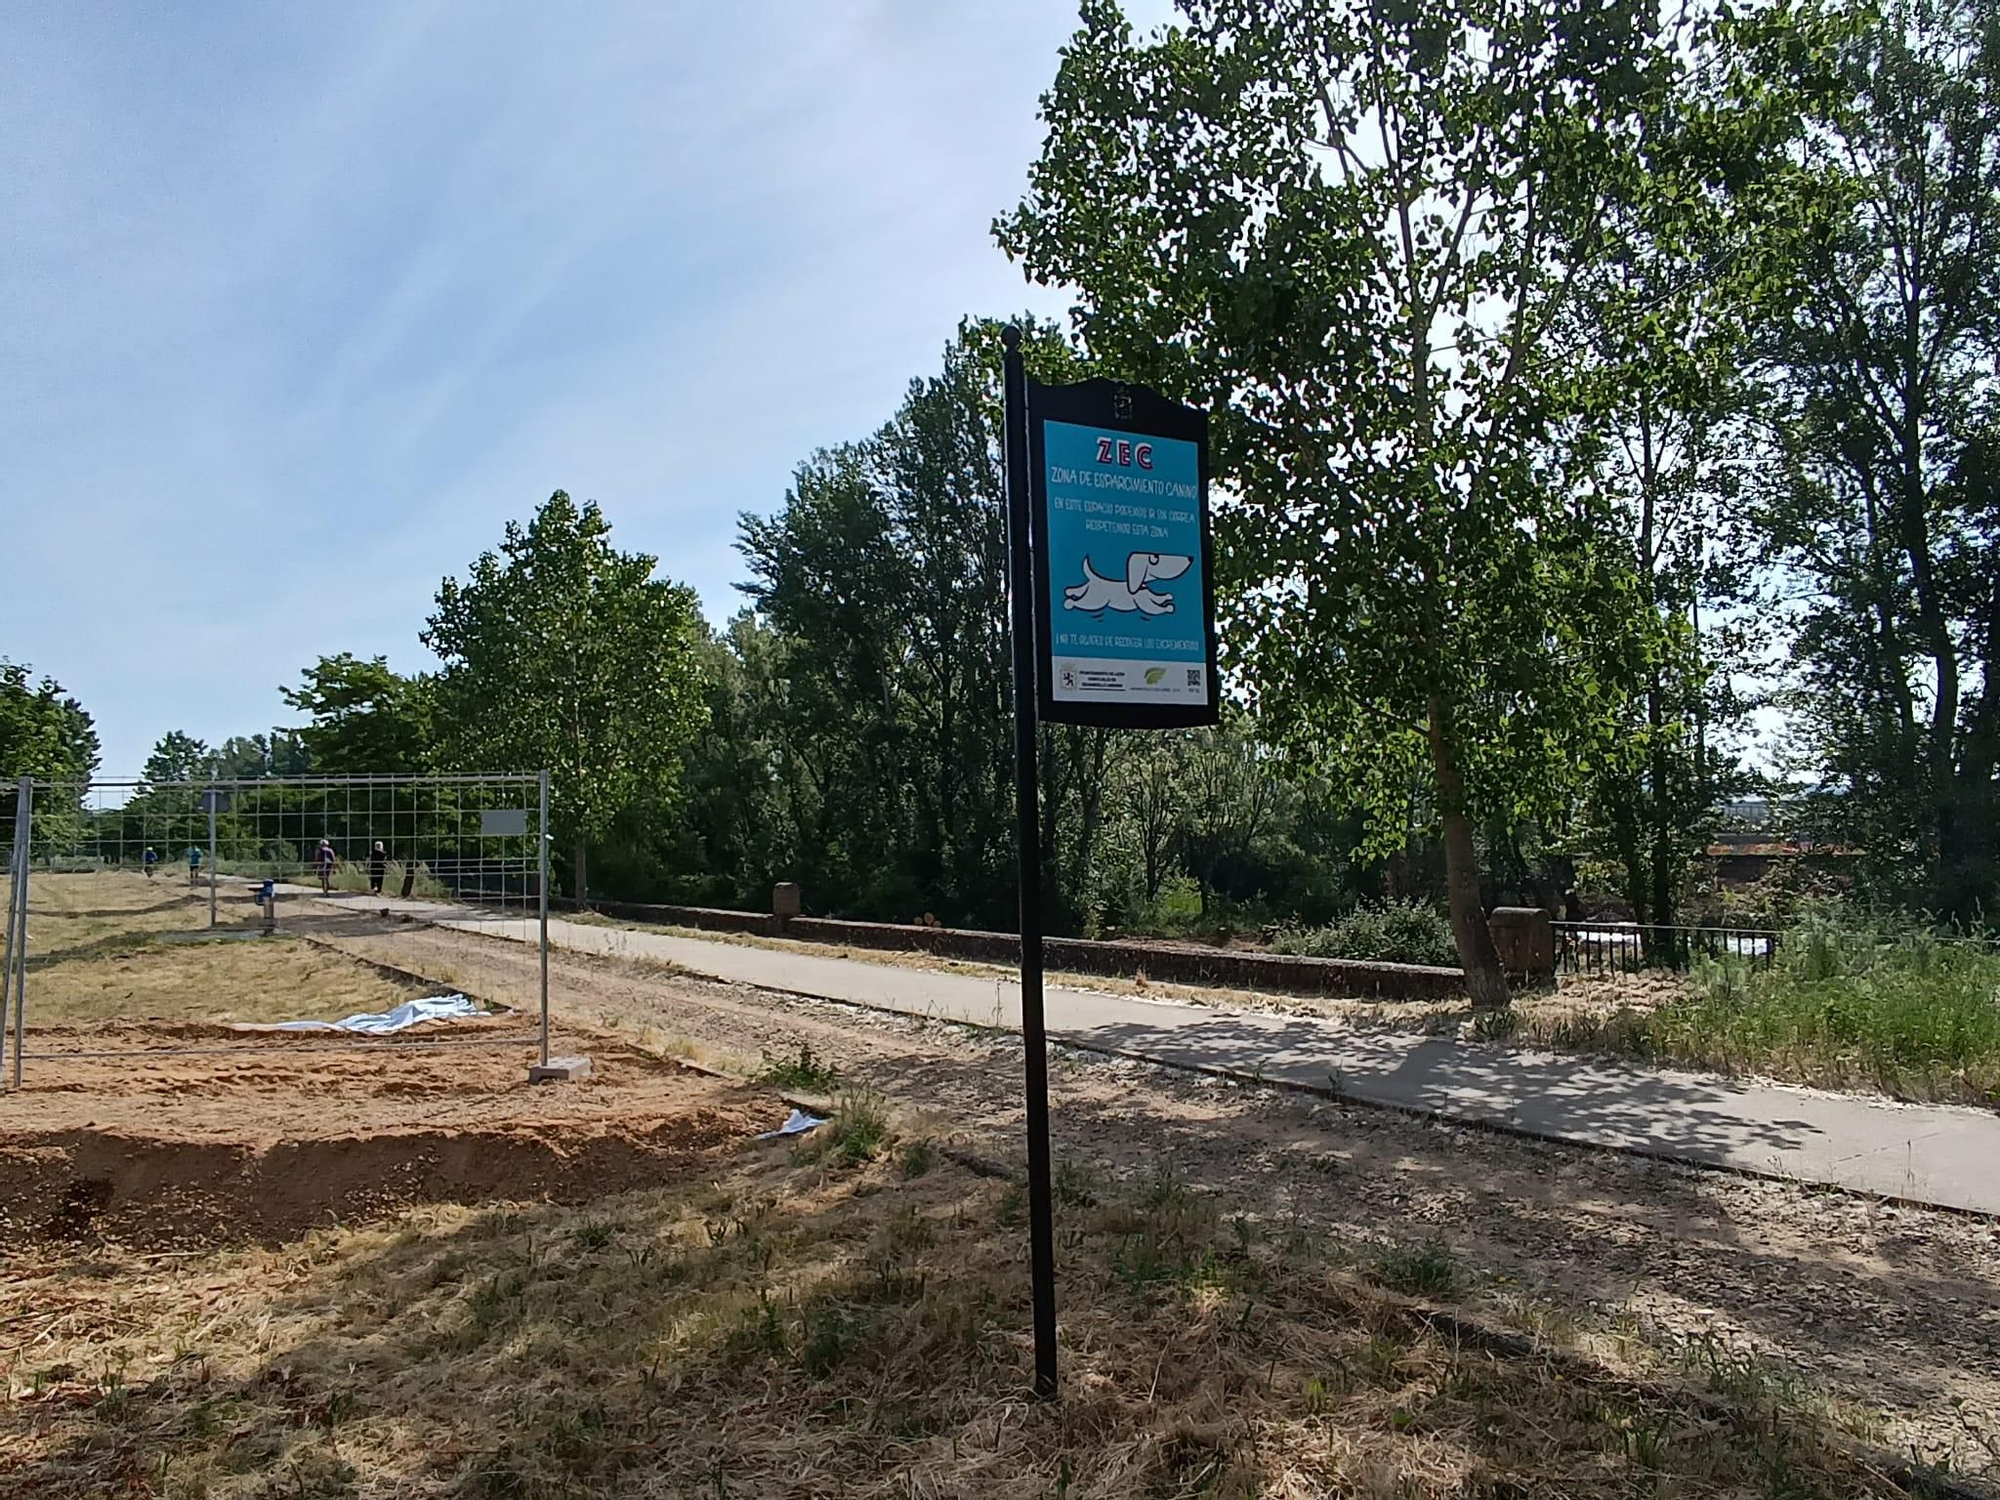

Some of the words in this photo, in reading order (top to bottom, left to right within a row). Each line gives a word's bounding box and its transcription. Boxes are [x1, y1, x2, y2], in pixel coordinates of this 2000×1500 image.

[1096, 437, 1153, 470] ZEC
[1051, 467, 1077, 484] ZONA
[1079, 471, 1092, 486] DE
[1094, 472, 1164, 496] ESPARCIMIENTO
[1165, 482, 1198, 500] CANINO
[1055, 496, 1064, 508] EN
[1149, 525, 1169, 538] ZONA
